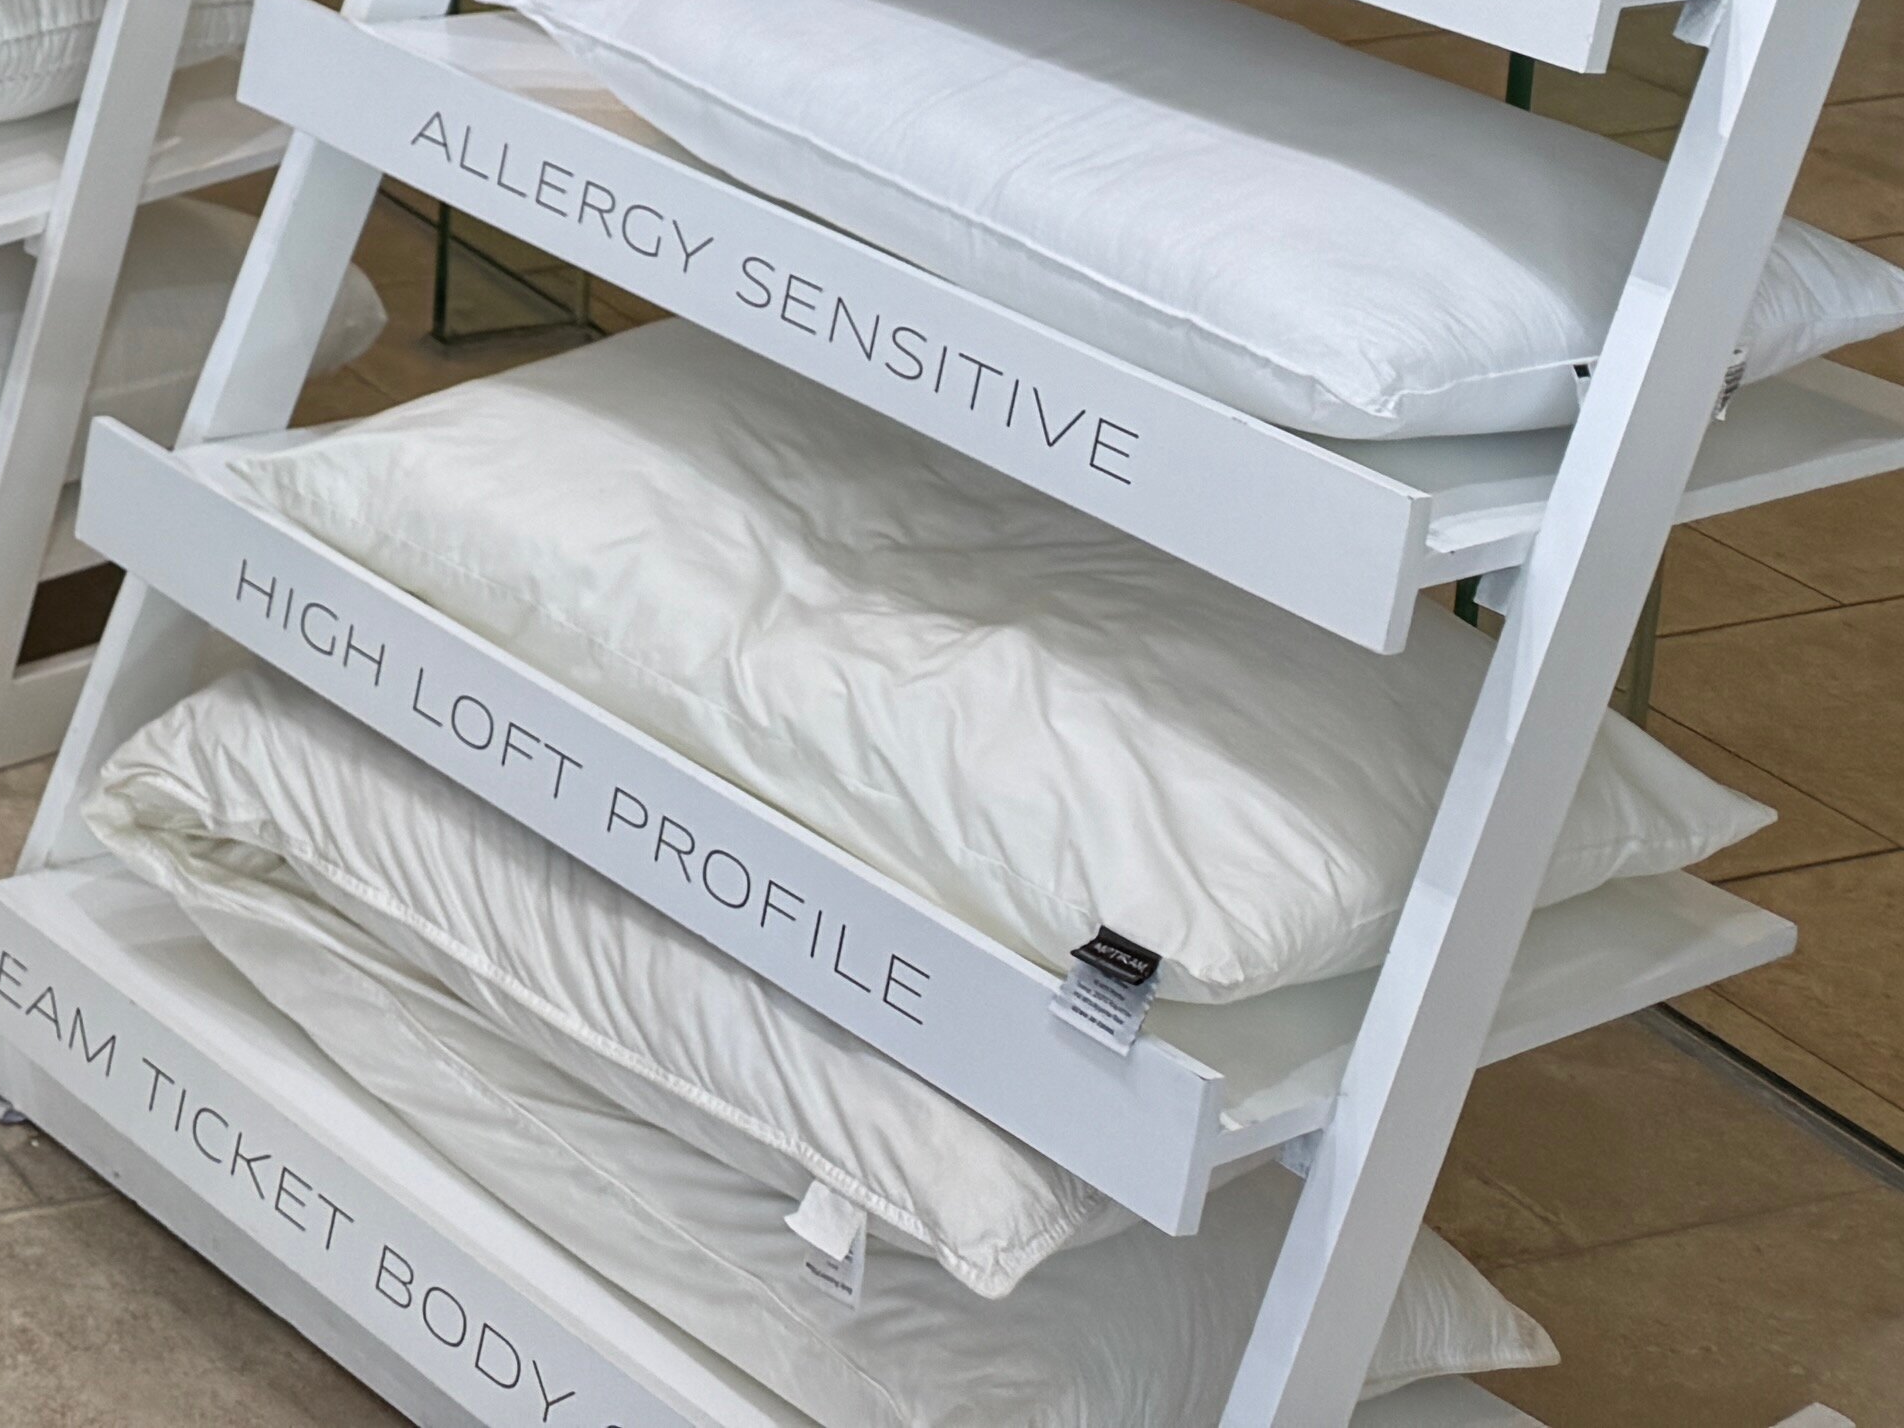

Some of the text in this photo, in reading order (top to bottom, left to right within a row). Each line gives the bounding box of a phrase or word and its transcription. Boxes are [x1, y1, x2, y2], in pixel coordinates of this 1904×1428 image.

[409, 110, 1141, 487] ALLERGY SENSITIVE
[235, 557, 387, 688] HIGH
[411, 665, 585, 801] LOFT
[605, 785, 932, 1027] PROFILE
[140, 1056, 356, 1252] TICKET
[373, 1243, 577, 1425] BODY
